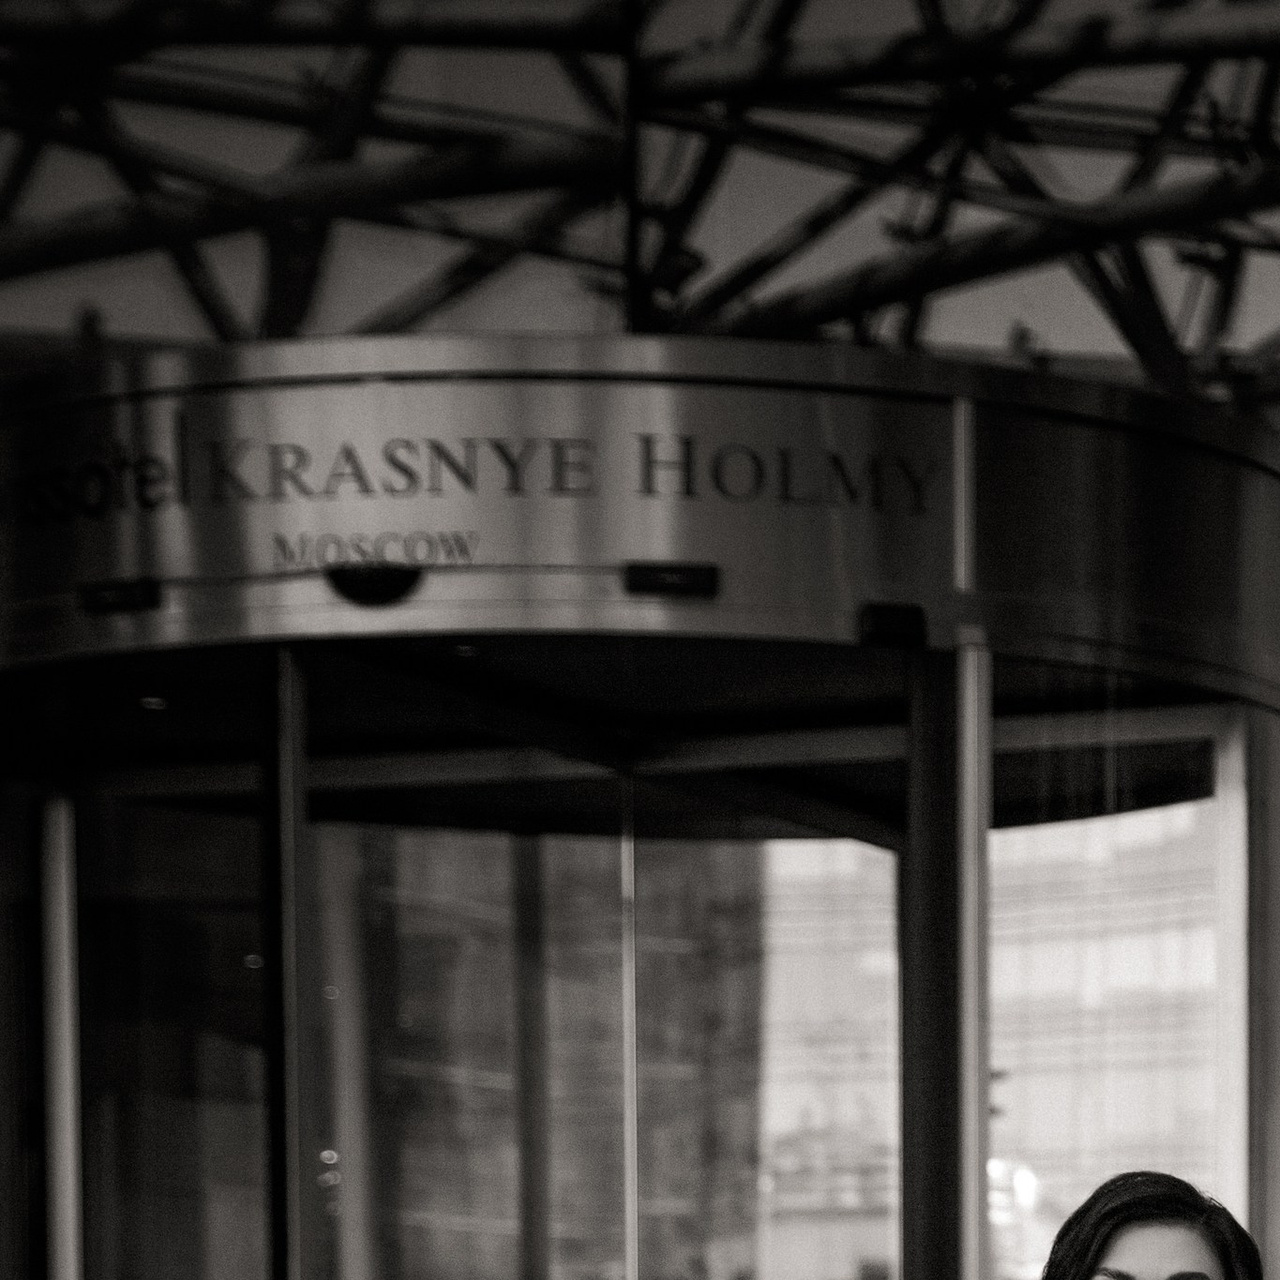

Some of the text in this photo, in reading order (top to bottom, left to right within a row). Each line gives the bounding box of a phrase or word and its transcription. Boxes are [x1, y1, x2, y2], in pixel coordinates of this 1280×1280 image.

[204, 437, 596, 500] KRASNYE
[631, 430, 940, 516] HOLMY
[271, 531, 480, 568] MOSCOW
